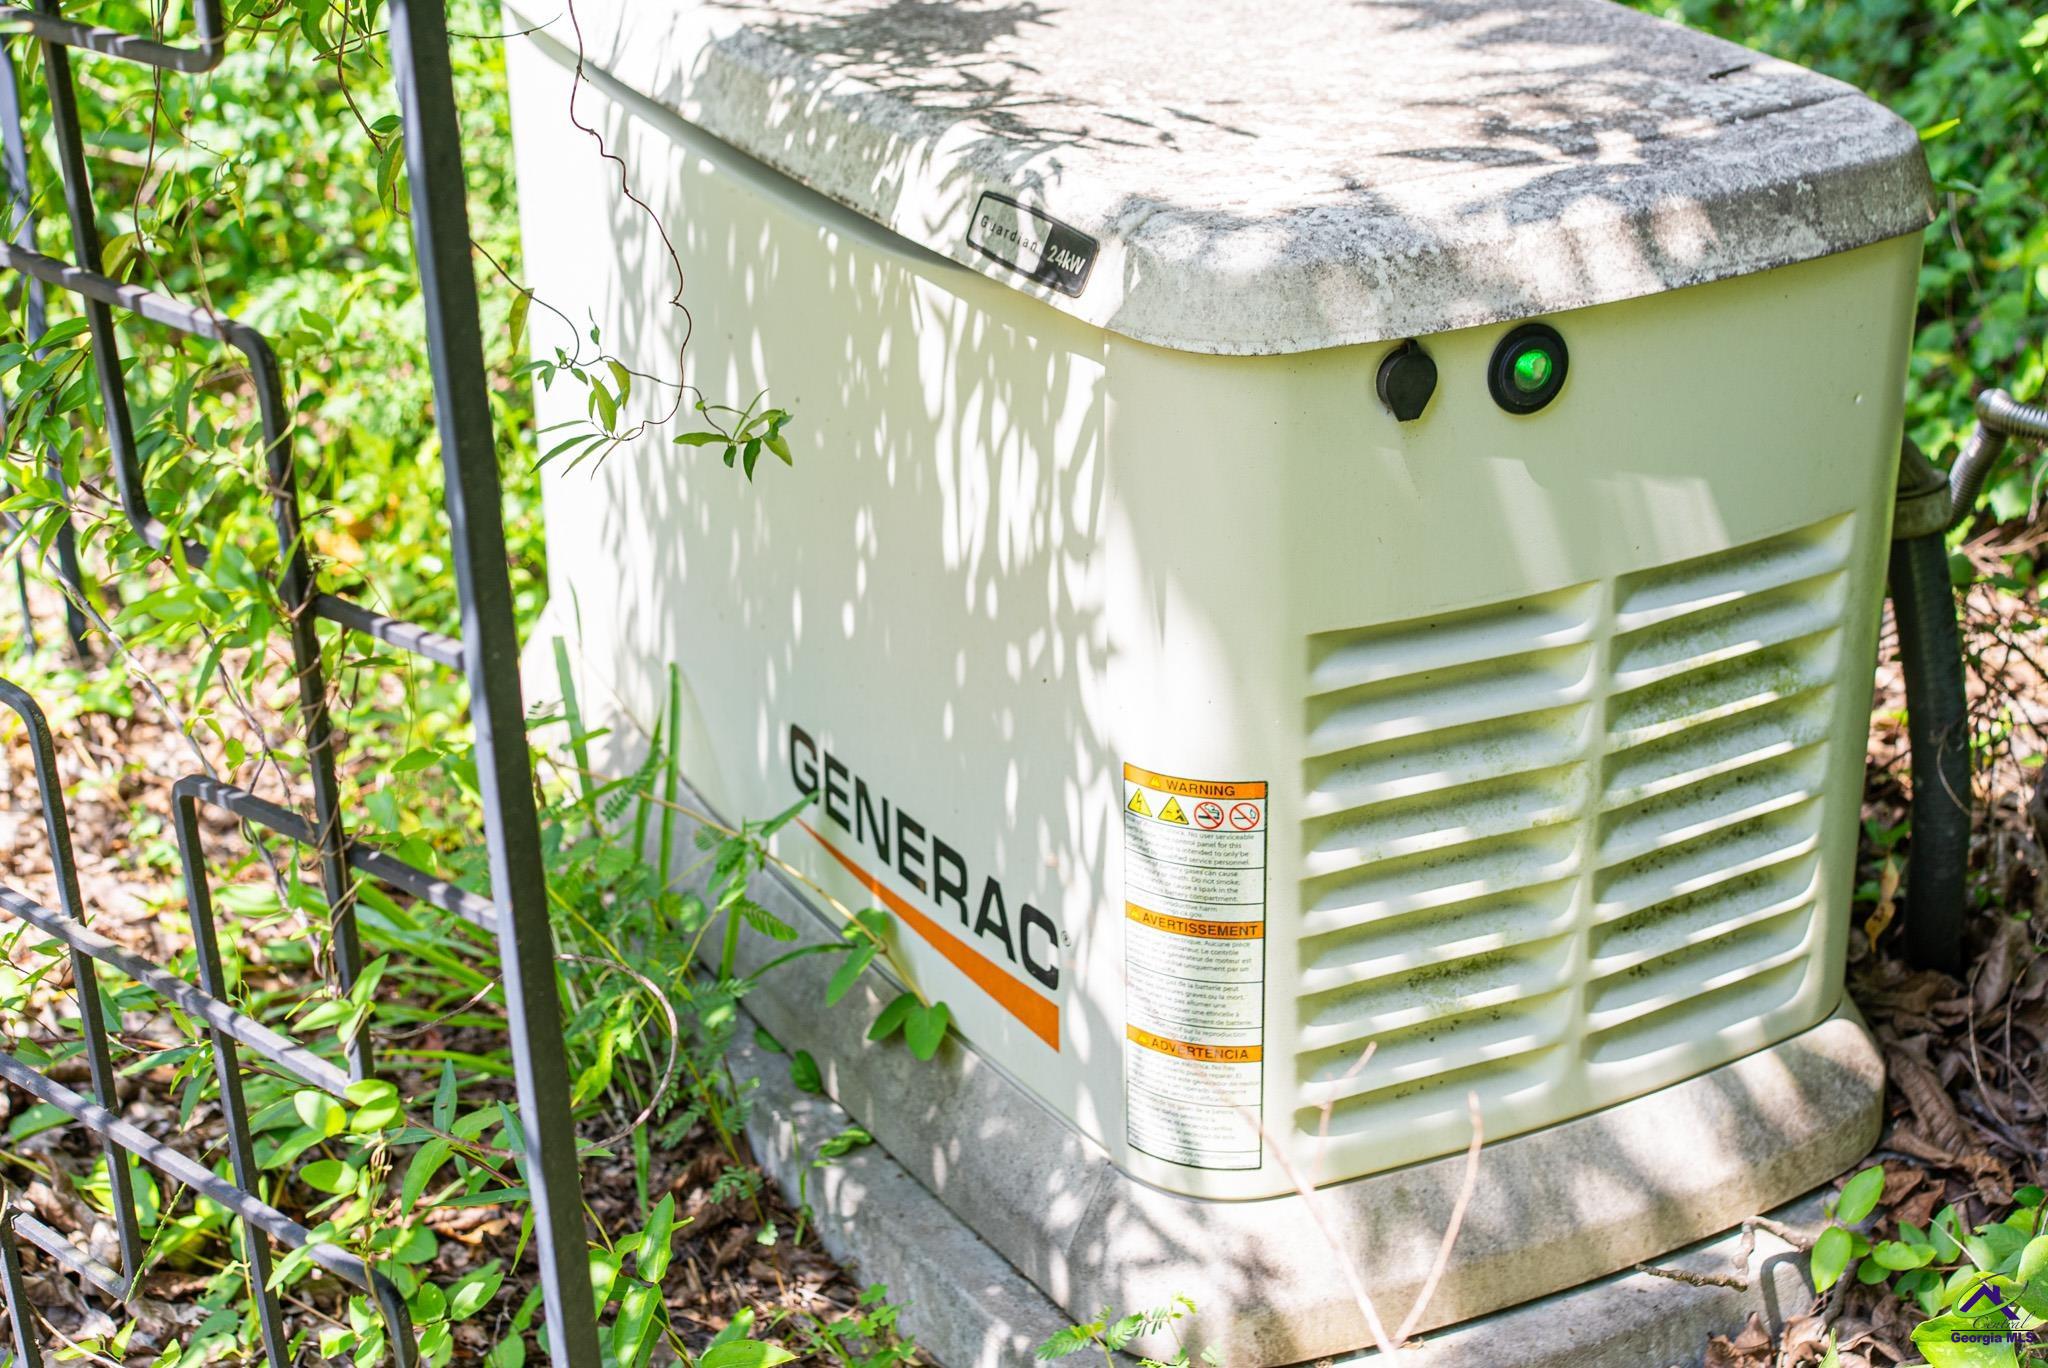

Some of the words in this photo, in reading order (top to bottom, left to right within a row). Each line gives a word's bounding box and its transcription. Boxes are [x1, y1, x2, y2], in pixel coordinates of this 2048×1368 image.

[981, 216, 1037, 253] Guardian
[1047, 245, 1086, 274] 24kW
[1166, 779, 1235, 796] WARNING
[790, 723, 1059, 990] GENERAC
[1143, 913, 1257, 936] AVERTISSEMENT
[1152, 1038, 1248, 1059] ADVERTENCIA
